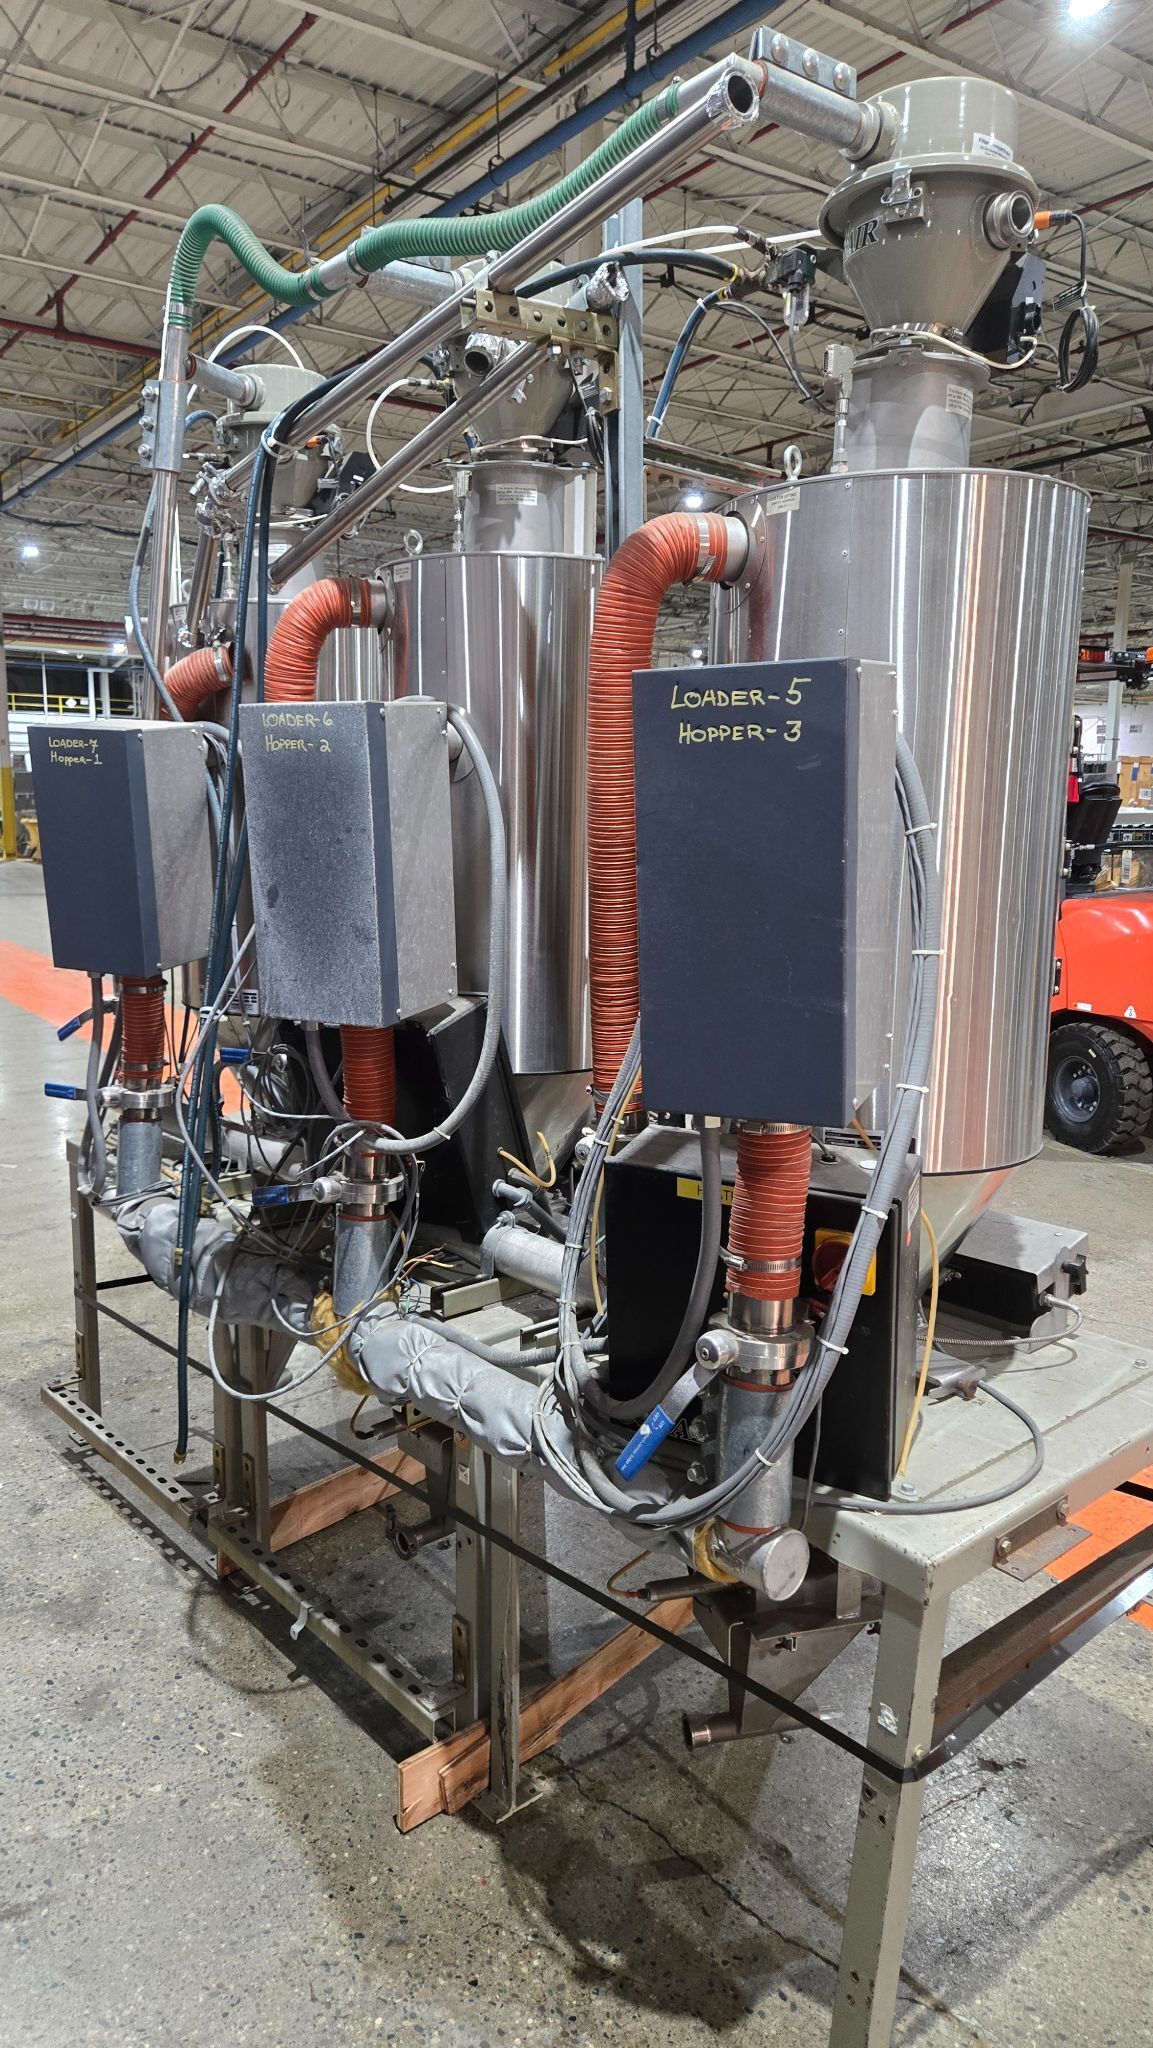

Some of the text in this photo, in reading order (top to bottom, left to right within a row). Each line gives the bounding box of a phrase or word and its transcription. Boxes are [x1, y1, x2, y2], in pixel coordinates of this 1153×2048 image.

[671, 677, 812, 710] LOADER-5
[262, 711, 334, 728] LOADER-6
[679, 720, 802, 745] HOPPER-3
[48, 736, 99, 754] LOADER-7
